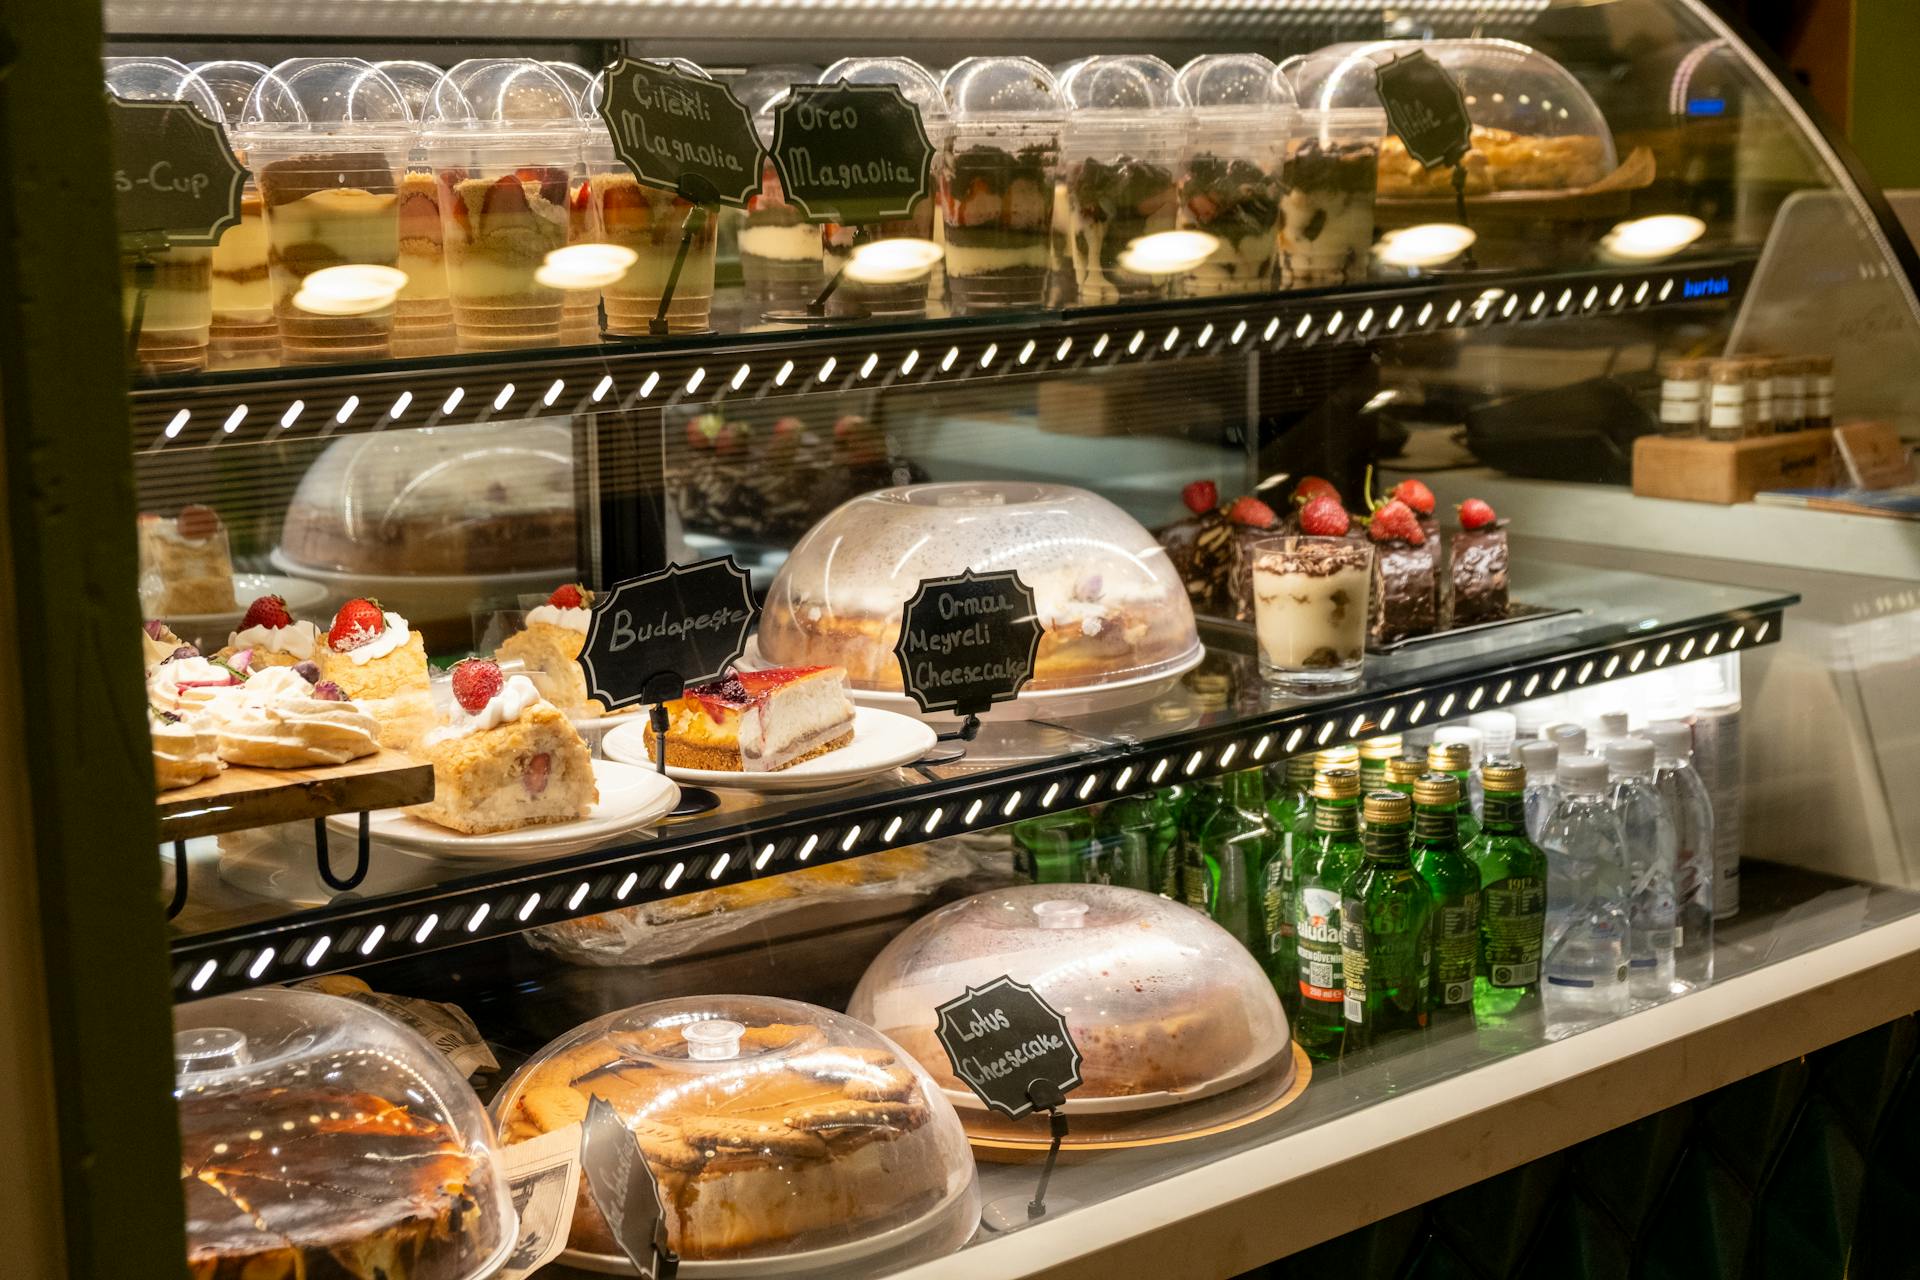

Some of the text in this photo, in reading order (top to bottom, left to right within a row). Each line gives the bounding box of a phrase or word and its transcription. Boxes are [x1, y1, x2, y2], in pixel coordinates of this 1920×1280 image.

[796, 102, 858, 131] Oreo
[621, 108, 744, 172] Magnolia
[788, 146, 915, 190] Magnolia
[608, 606, 748, 652] Budapeşte
[915, 657, 1027, 690] Cheesecake
[946, 1008, 1011, 1042] Lotus
[962, 1034, 1064, 1085] Cheesecake
